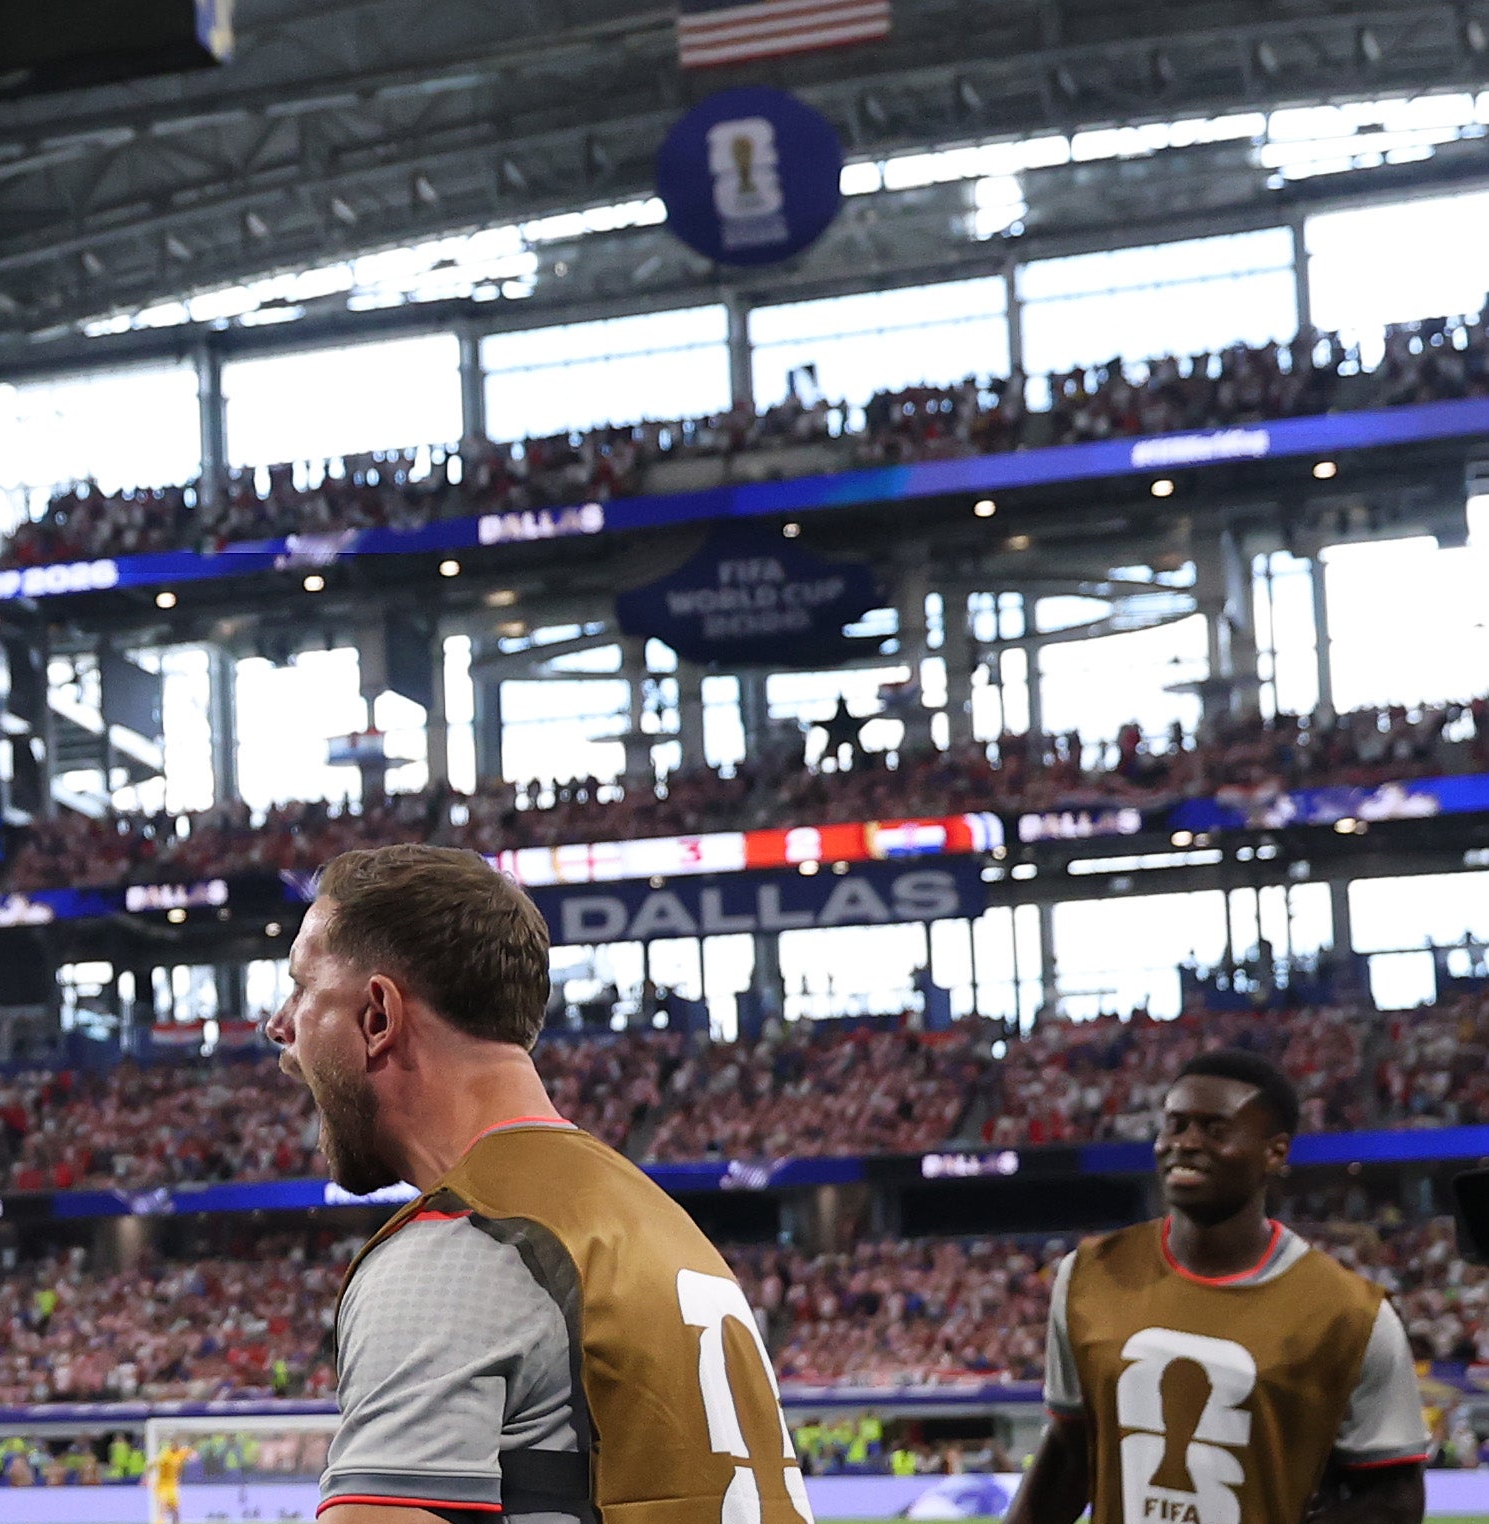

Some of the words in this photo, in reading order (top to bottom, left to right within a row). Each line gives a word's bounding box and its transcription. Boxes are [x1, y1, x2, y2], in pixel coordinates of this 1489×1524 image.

[478, 503, 604, 544] DALLAS
[22, 559, 118, 597] 2026
[718, 557, 784, 583] FIFA
[1019, 807, 1141, 842] DALLAS
[561, 870, 960, 942] DALLAS
[1144, 1497, 1201, 1524] FIFA
